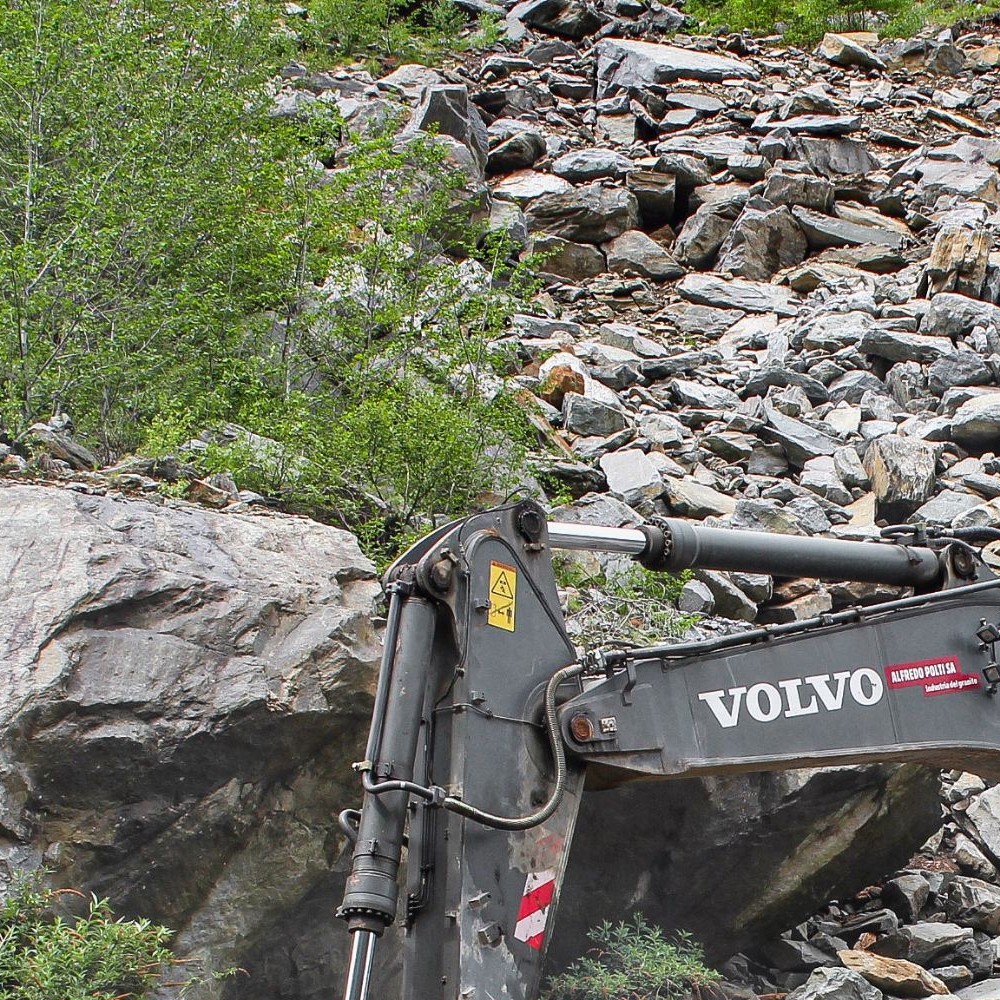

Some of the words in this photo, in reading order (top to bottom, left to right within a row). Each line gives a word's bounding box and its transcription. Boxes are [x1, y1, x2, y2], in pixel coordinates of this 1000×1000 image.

[891, 667, 924, 683] ALFREDO
[925, 663, 945, 677] POLTI
[945, 662, 957, 674] SA
[925, 681, 949, 692] Industria
[698, 667, 884, 728] VOLVO
